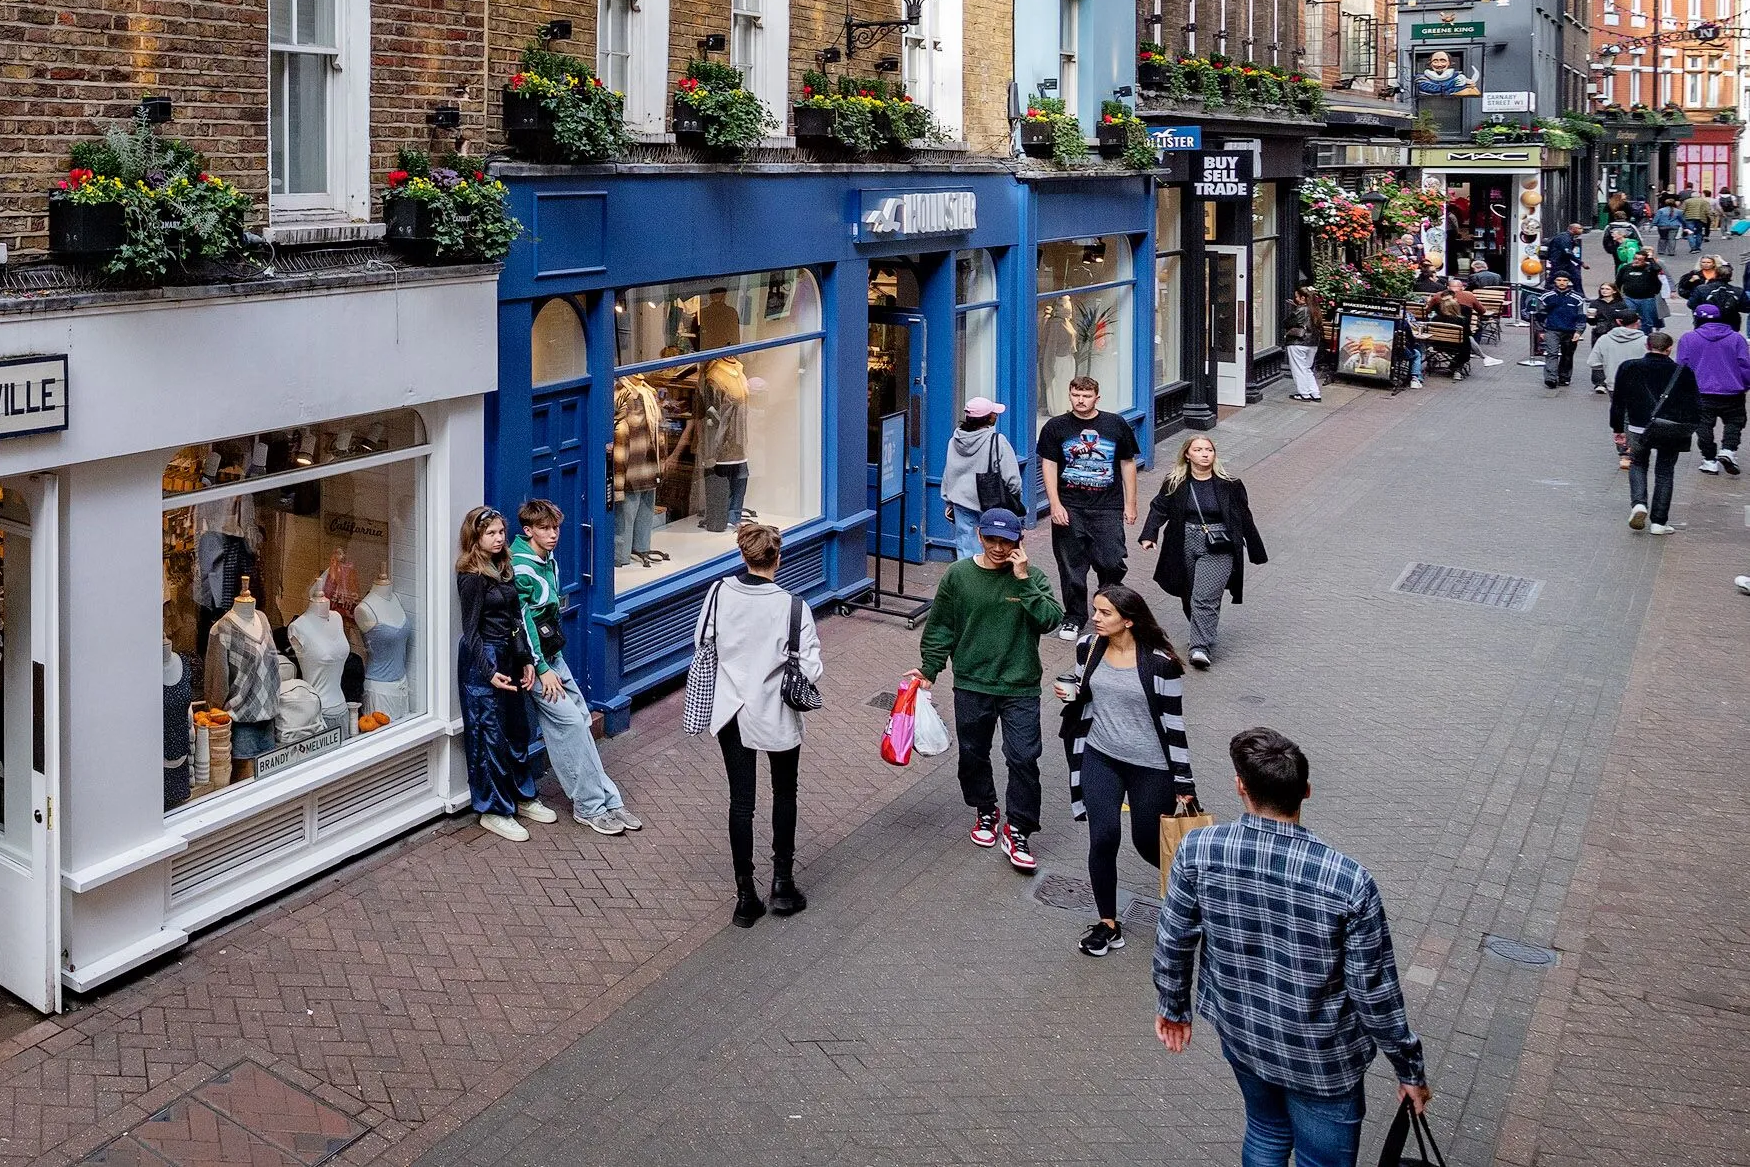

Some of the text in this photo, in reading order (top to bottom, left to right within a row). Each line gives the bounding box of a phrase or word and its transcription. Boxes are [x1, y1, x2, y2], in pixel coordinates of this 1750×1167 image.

[1203, 156, 1240, 169] BUY
[1203, 169, 1239, 183] SELL
[1194, 182, 1248, 195] TRADE
[903, 191, 977, 234] HOLLISTER
[330, 517, 383, 538] California
[259, 732, 339, 773] BRANDY MELVILLE
